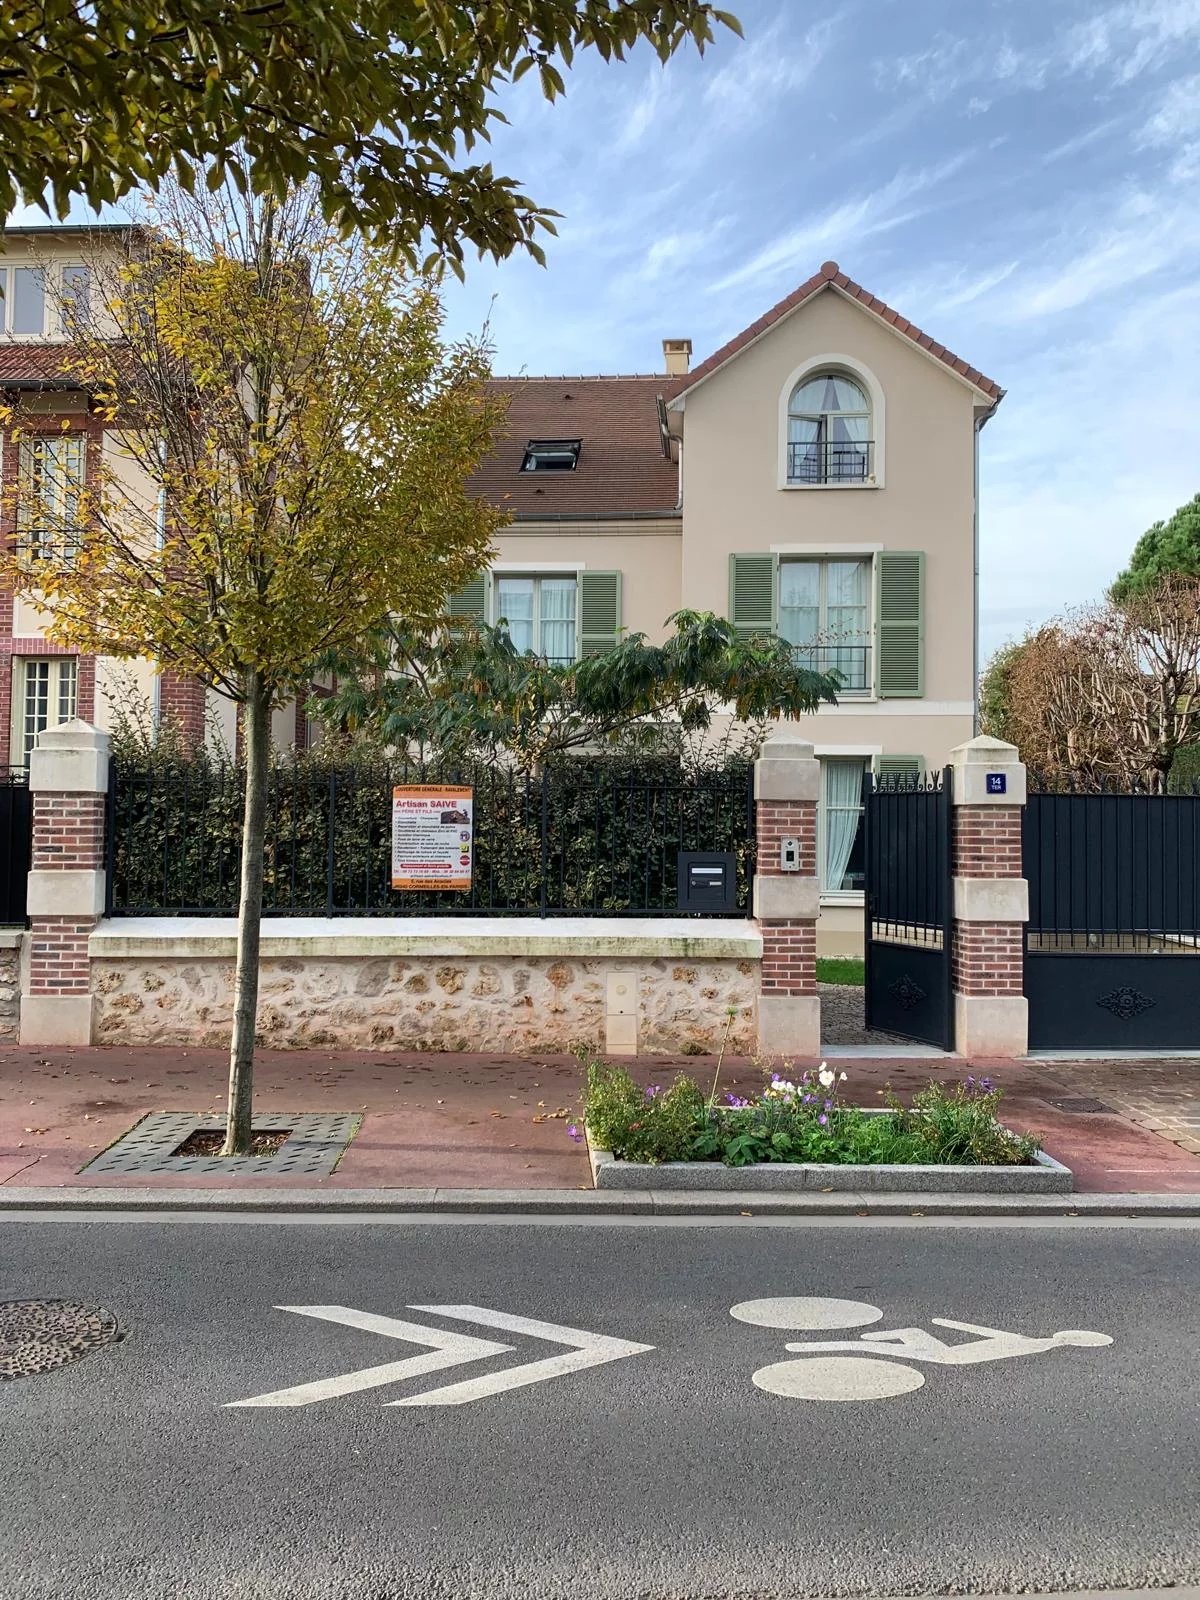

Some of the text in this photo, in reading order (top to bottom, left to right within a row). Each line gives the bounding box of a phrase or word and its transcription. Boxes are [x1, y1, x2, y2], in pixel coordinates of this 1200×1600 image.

[991, 777, 1001, 785] 14
[396, 800, 457, 808] Artisan SAIVE
